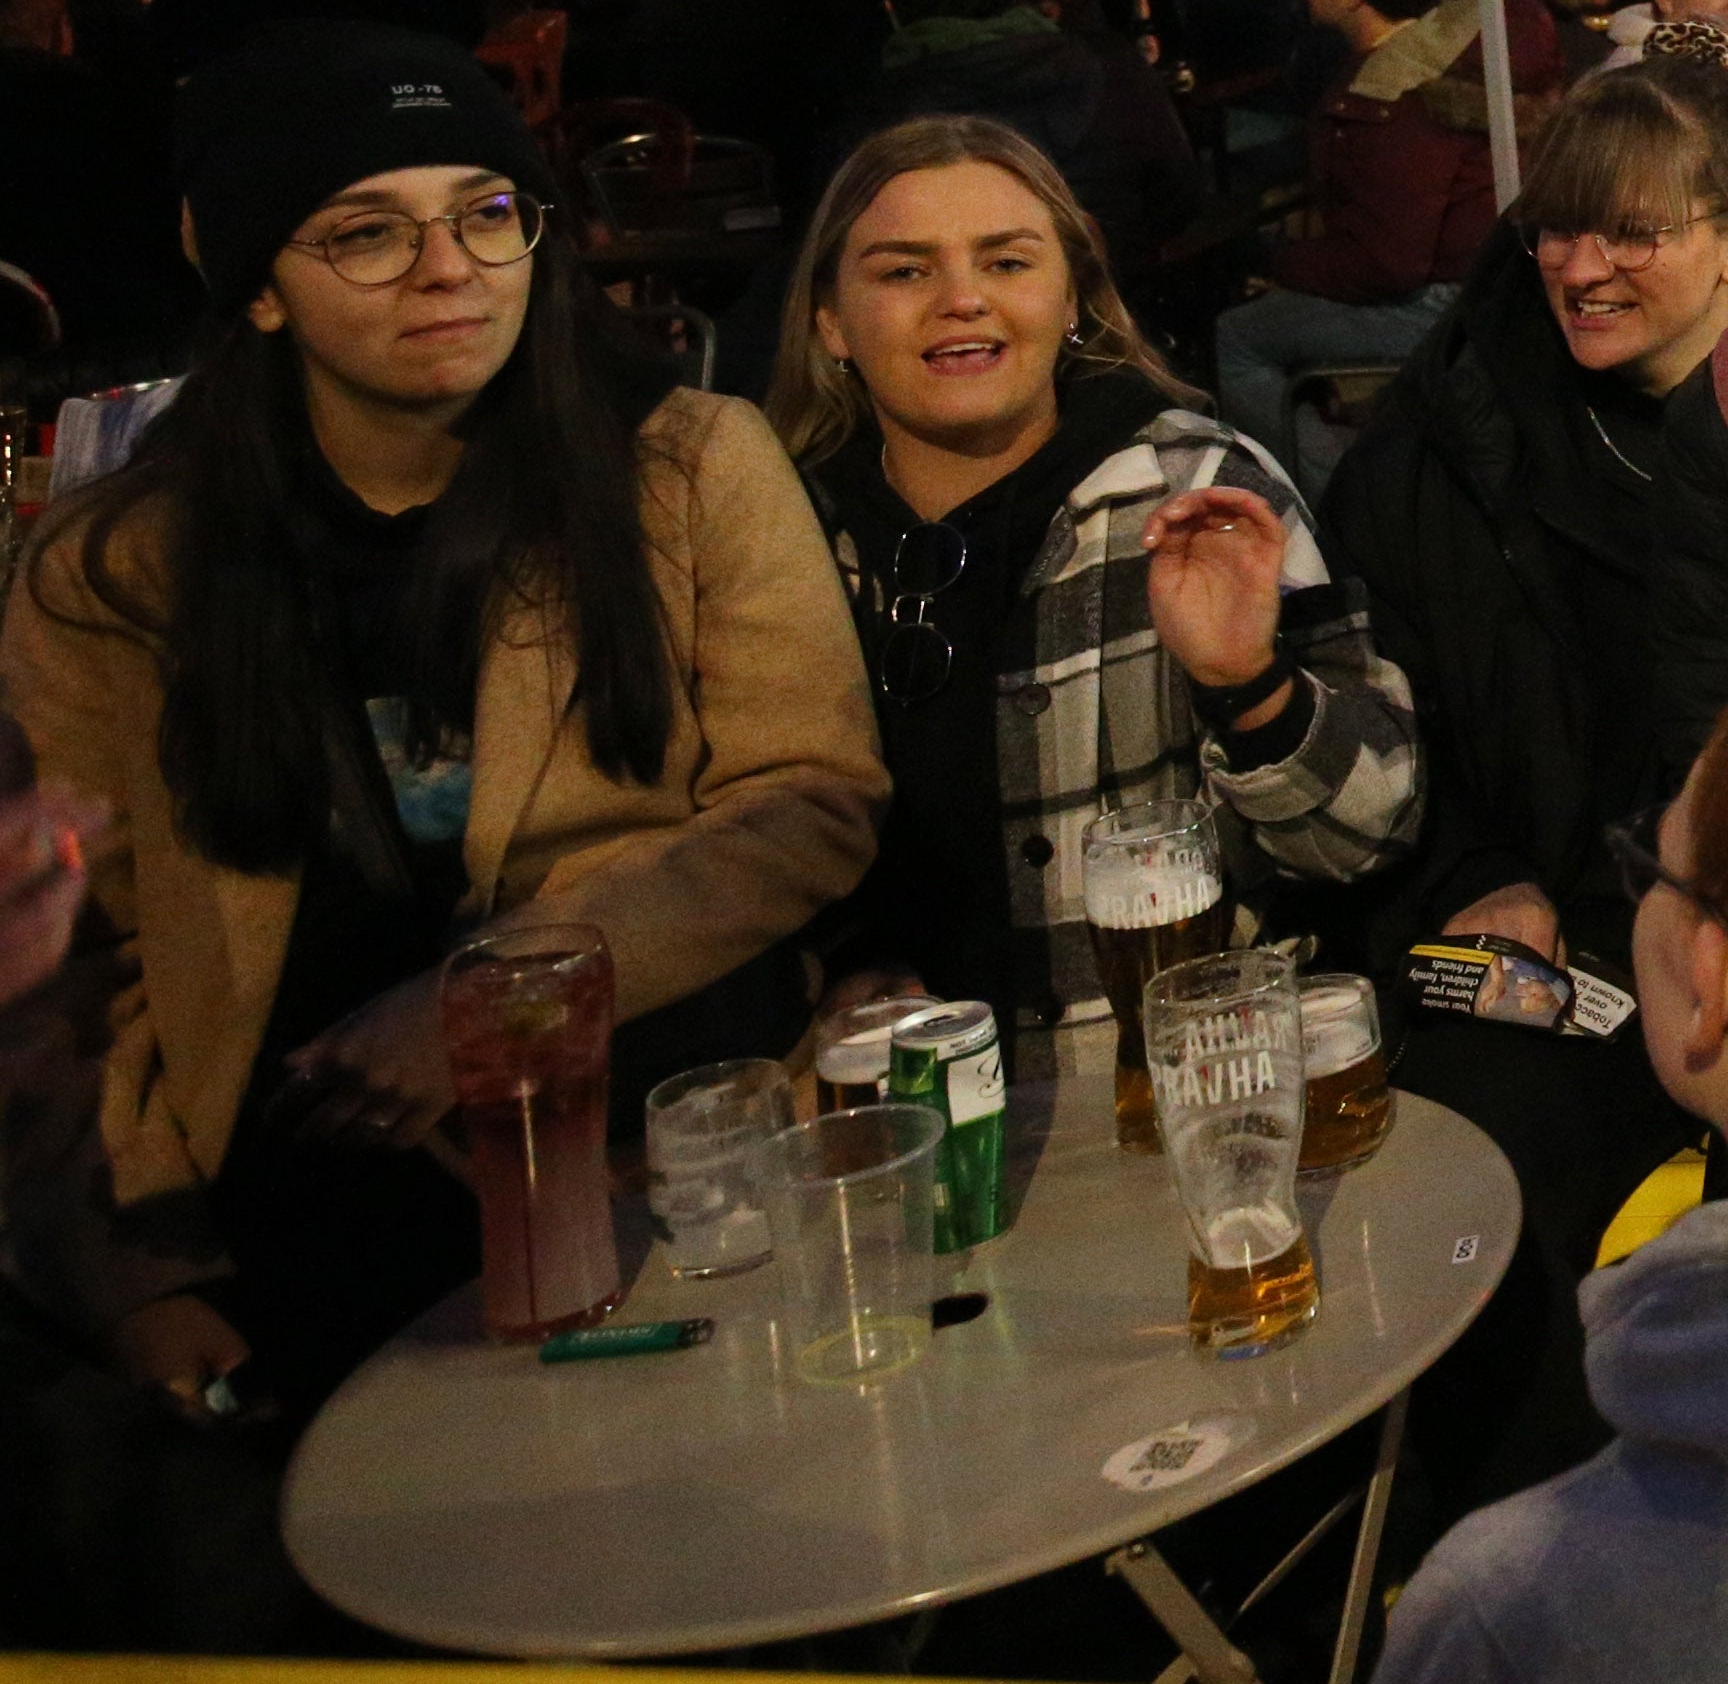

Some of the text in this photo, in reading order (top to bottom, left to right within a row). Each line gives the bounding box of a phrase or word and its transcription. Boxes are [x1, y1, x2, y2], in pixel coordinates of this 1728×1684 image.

[1408, 967, 1438, 984] family
[1431, 959, 1484, 975] and friends
[1424, 984, 1475, 1001] harms your
[1577, 979, 1625, 1009] known to
[1583, 995, 1607, 1009] over
